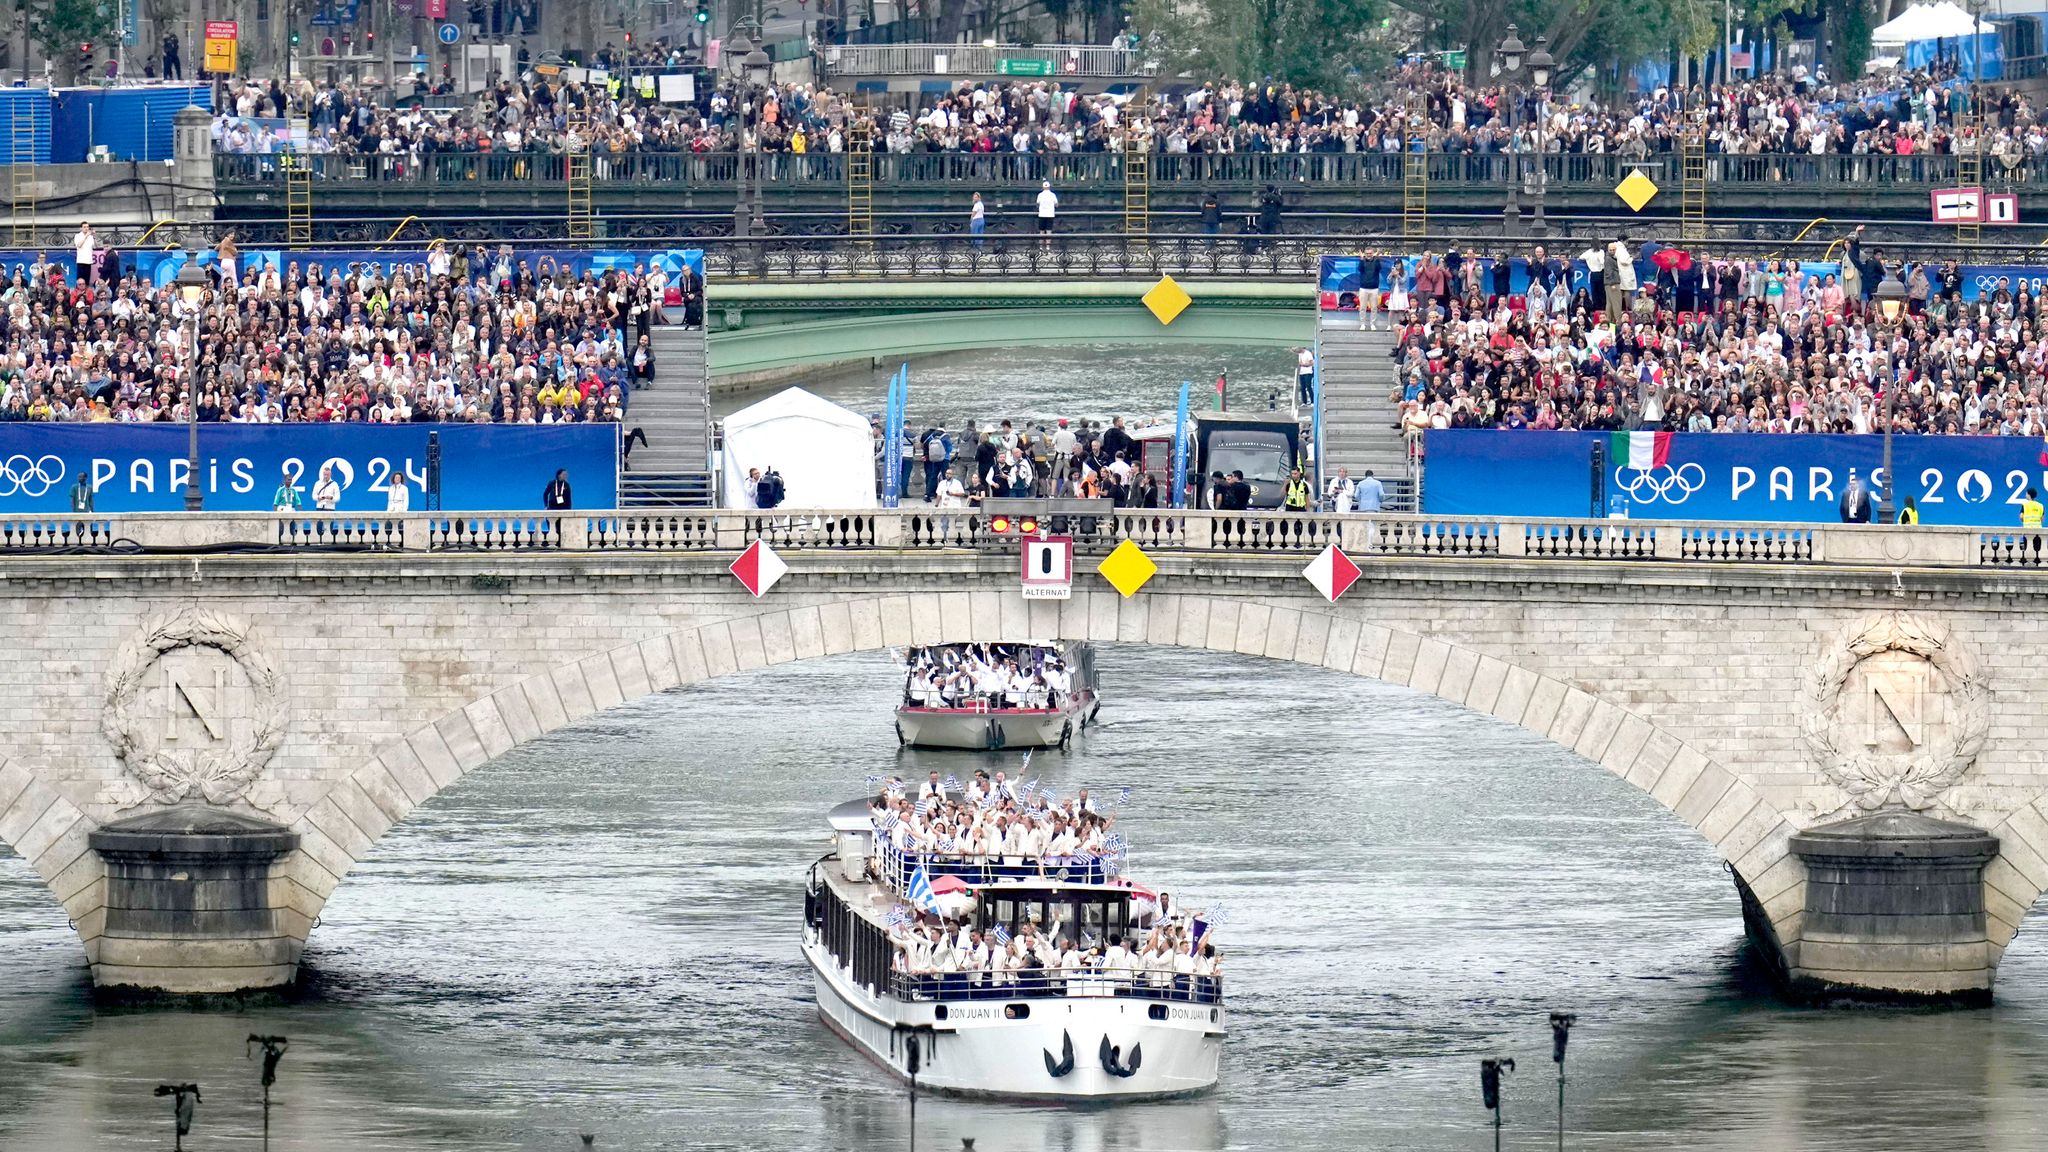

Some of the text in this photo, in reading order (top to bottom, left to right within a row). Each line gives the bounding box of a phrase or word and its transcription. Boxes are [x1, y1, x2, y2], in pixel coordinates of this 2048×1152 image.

[1025, 588, 1068, 597] ALTERNAT
[165, 665, 226, 740] N
[1864, 672, 1925, 746] N
[949, 1008, 1000, 1019] DON JUAN II
[1171, 1008, 1189, 1019] DON
[1190, 1009, 1204, 1020] JUAN
